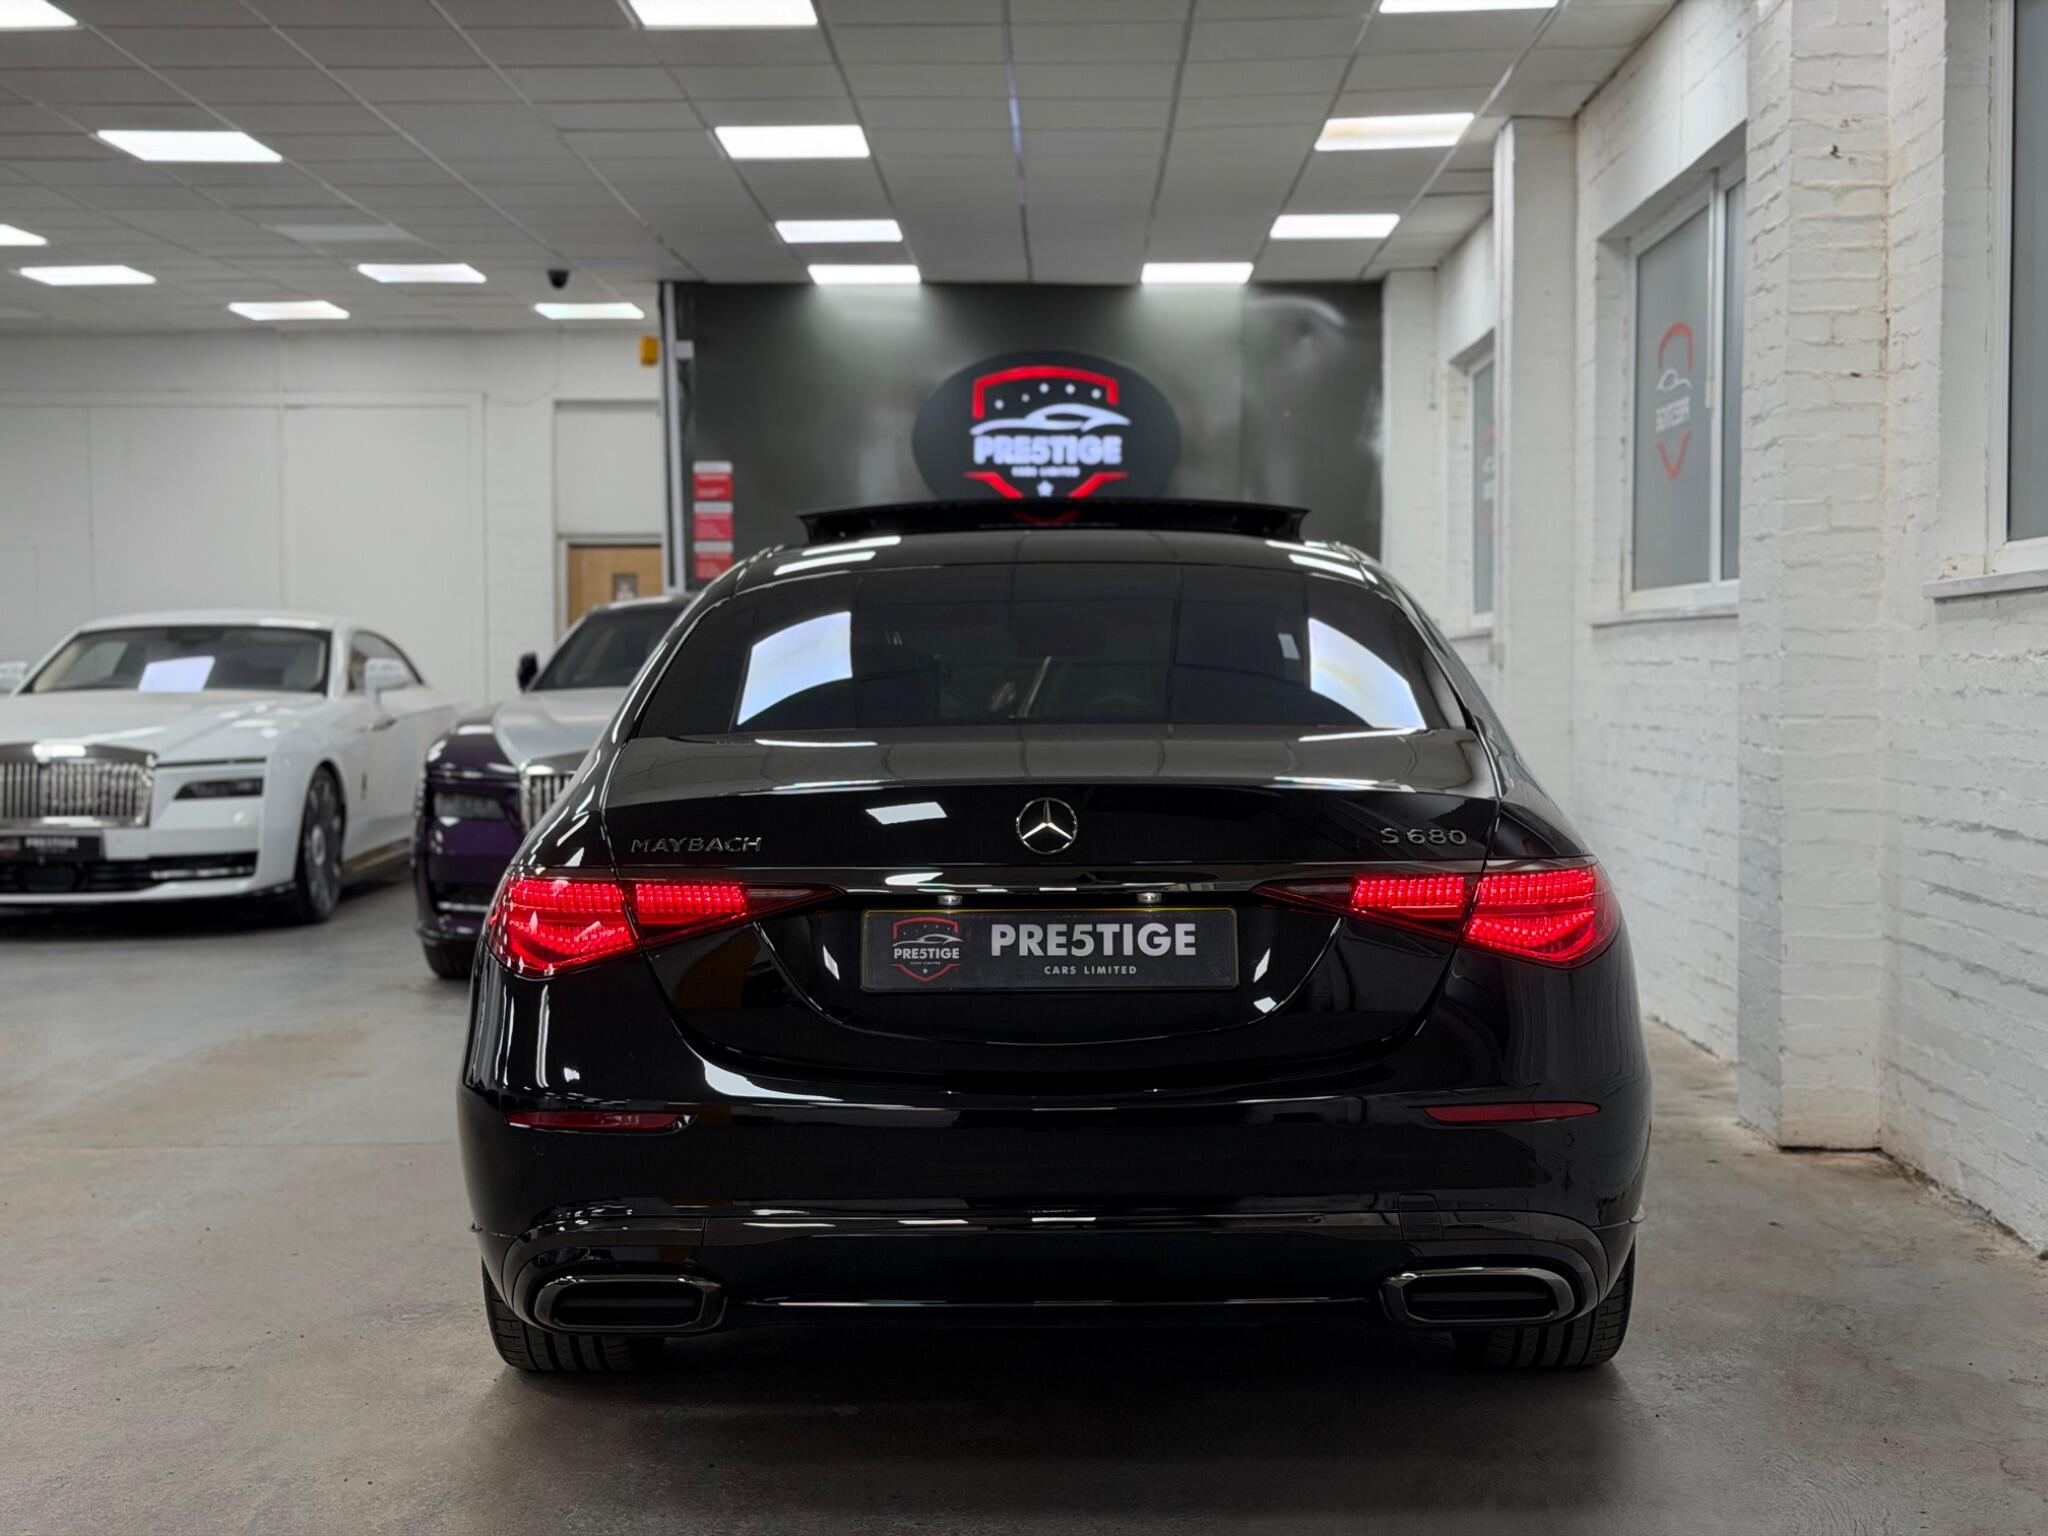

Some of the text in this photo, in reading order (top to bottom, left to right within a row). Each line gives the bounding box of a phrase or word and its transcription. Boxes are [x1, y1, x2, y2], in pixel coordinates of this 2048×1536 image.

[1380, 827, 1467, 845] S 680
[630, 837, 762, 853] MAYBACH
[1044, 965, 1138, 975] CARS LIMITED
